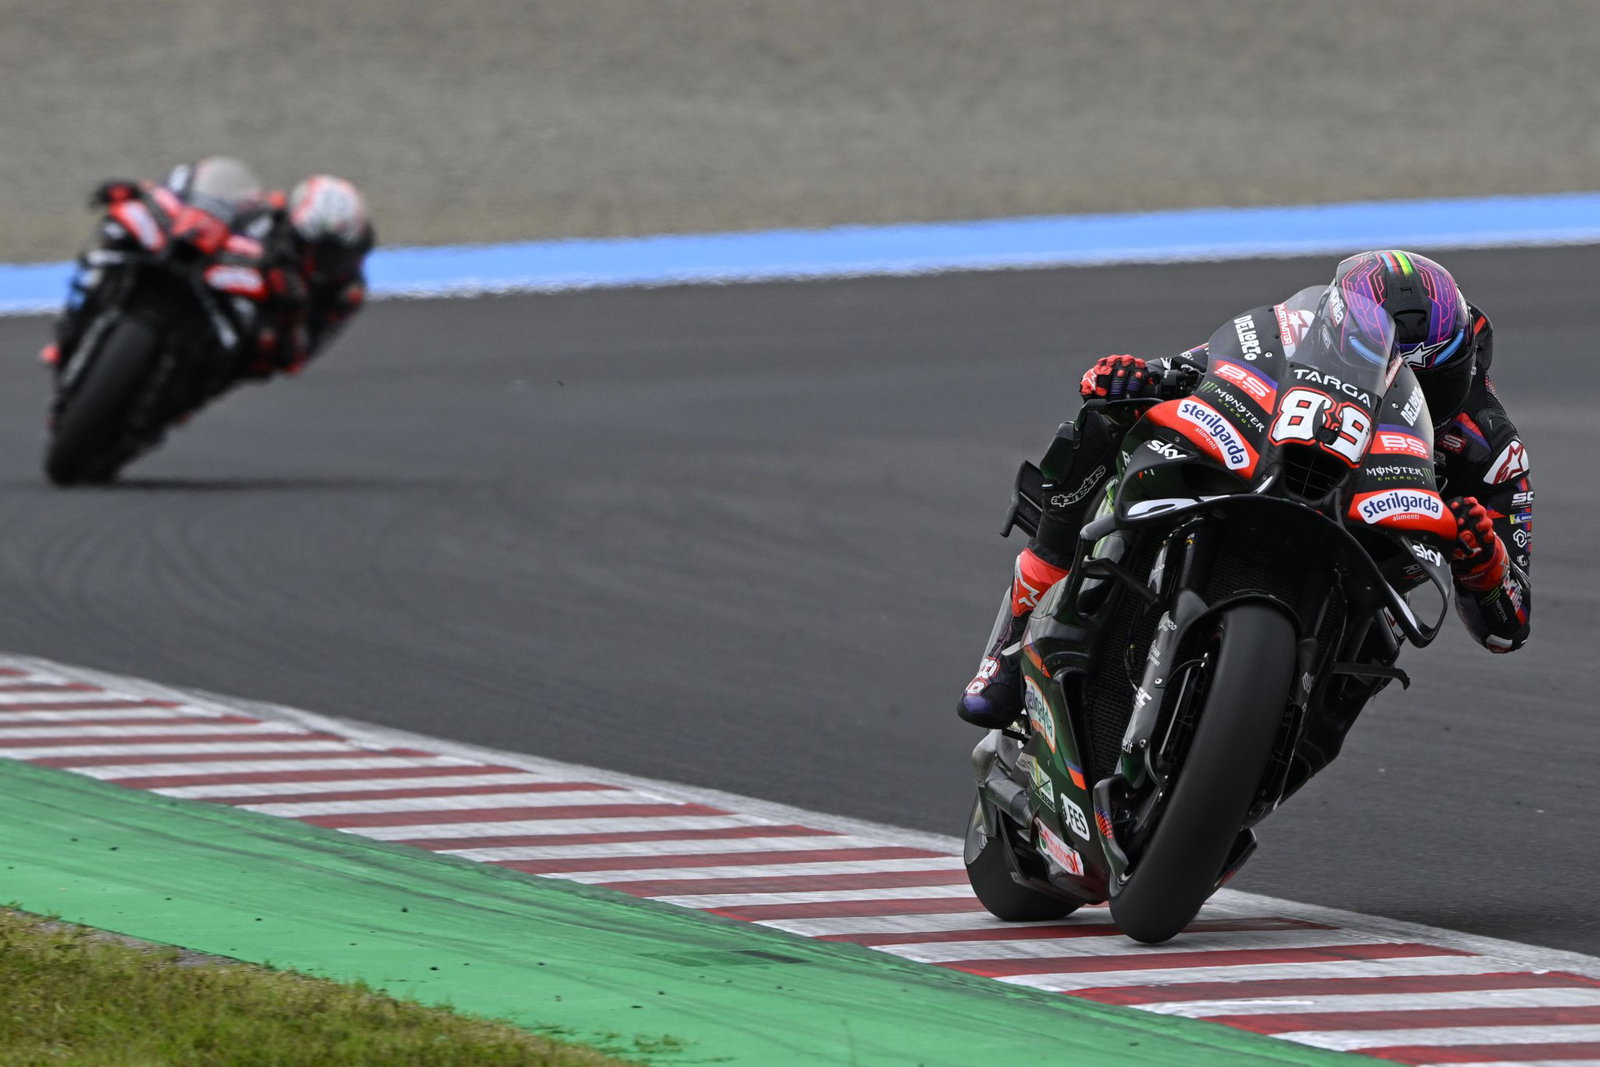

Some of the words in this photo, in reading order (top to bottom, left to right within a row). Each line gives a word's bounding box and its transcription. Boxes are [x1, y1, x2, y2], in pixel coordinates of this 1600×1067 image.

[1217, 364, 1271, 397] BS
[1293, 369, 1371, 409] TARGA
[1215, 388, 1265, 433] MONSTER
[1271, 388, 1372, 466] 89
[1181, 403, 1245, 465] sterilgarda
[1194, 427, 1218, 450] alimenti
[1380, 434, 1427, 454] BS
[1050, 464, 1107, 508] alpinestars
[1365, 466, 1425, 477] MONSTER
[1363, 492, 1440, 518] sterilgarda
[1392, 513, 1420, 522] alimenti
